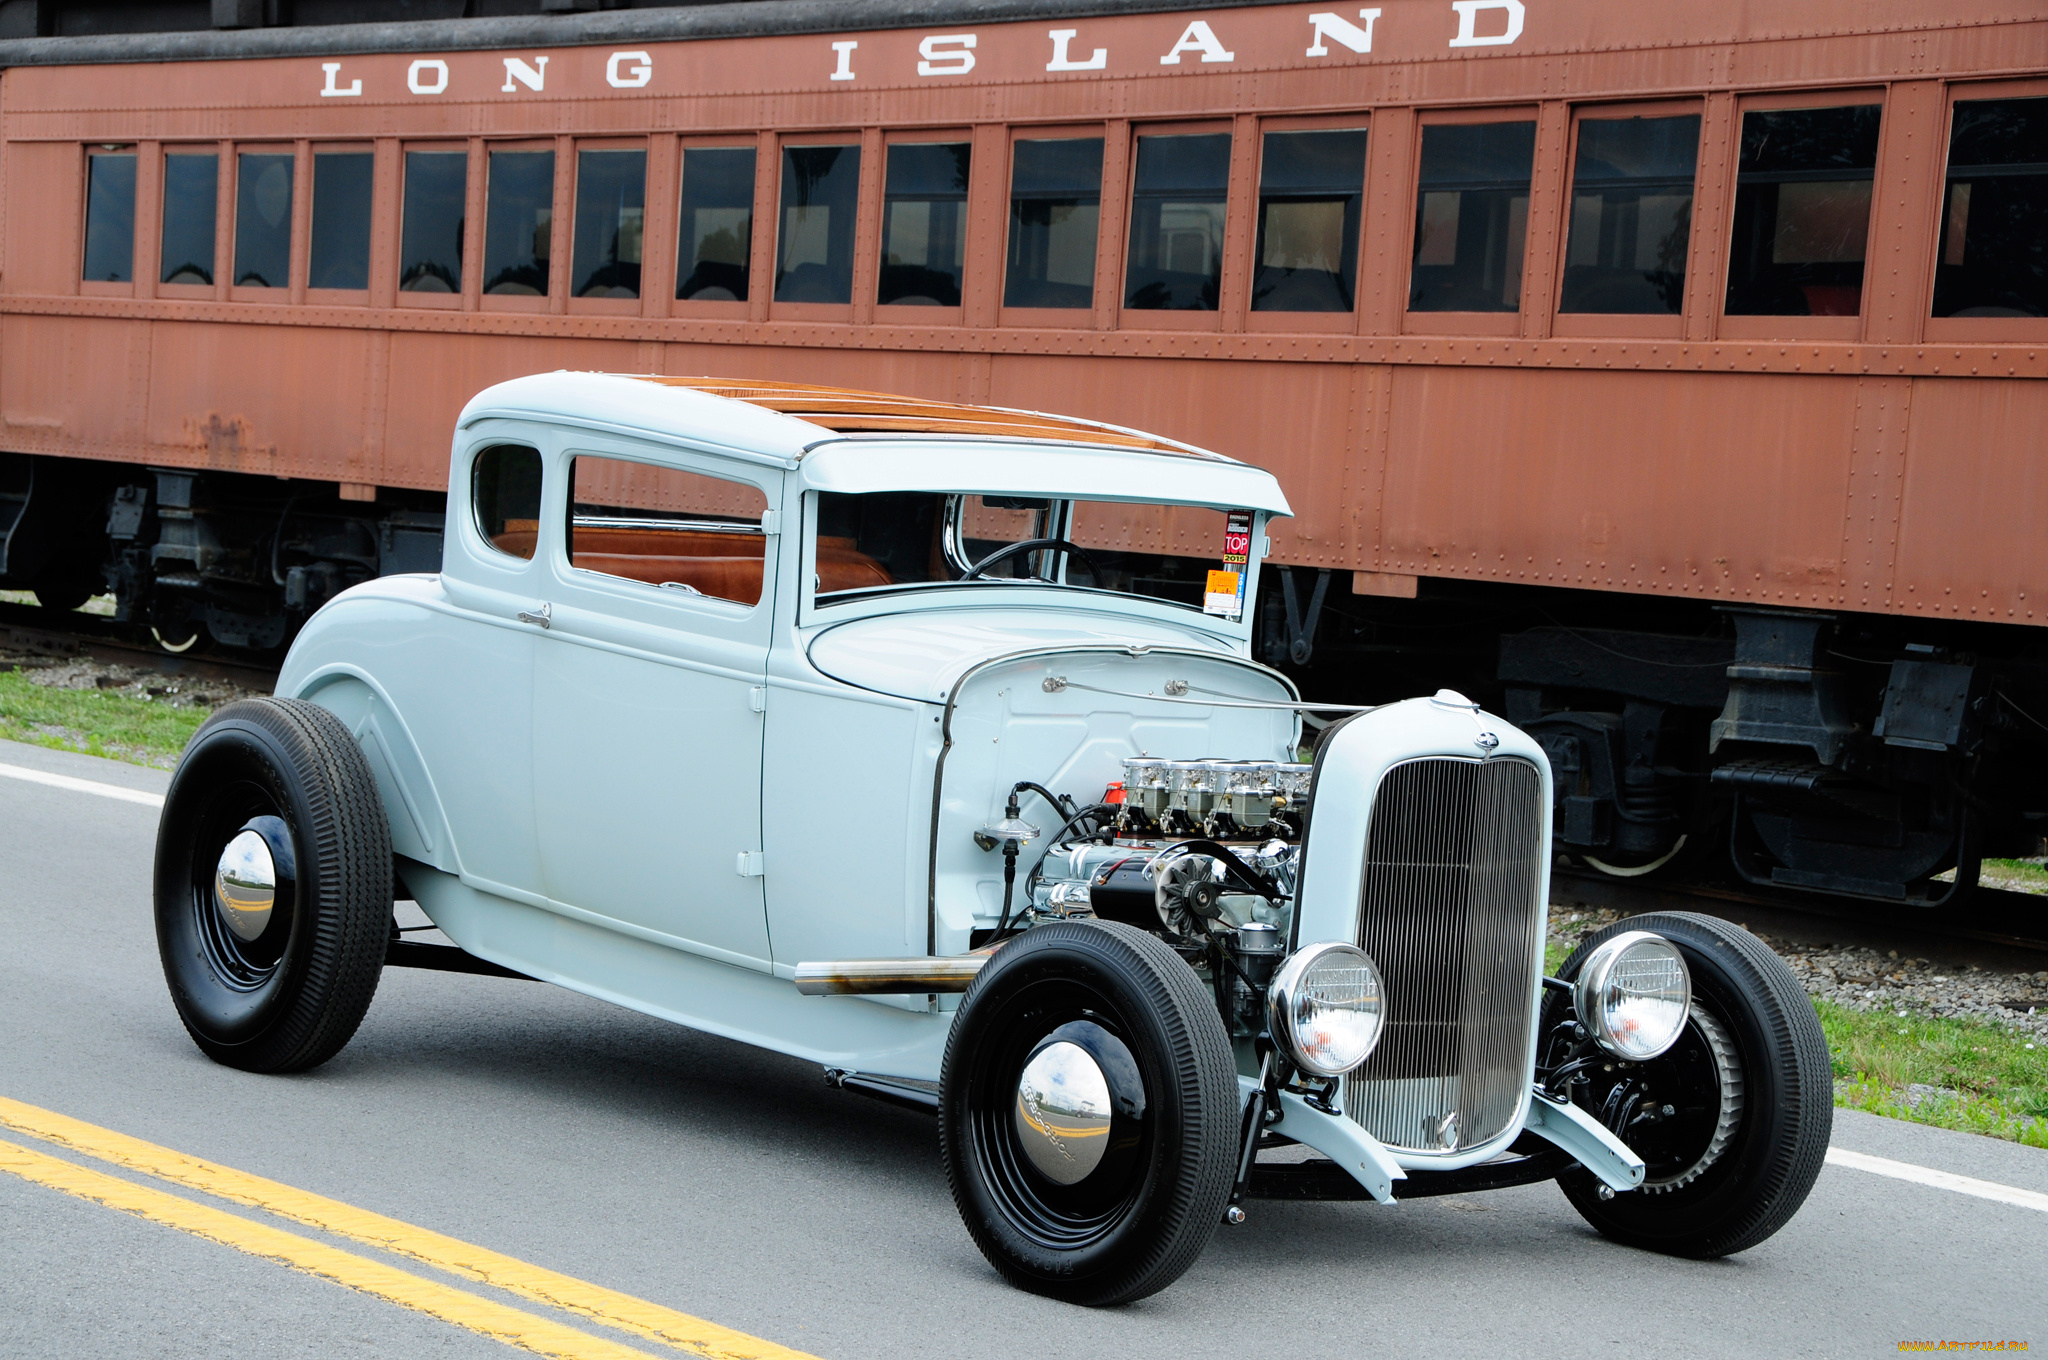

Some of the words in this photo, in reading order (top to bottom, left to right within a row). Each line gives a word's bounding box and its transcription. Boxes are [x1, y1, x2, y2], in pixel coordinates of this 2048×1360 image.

[320, 50, 652, 98] LONG
[830, 0, 1526, 82] ISLAND
[1225, 536, 1248, 551] TOP
